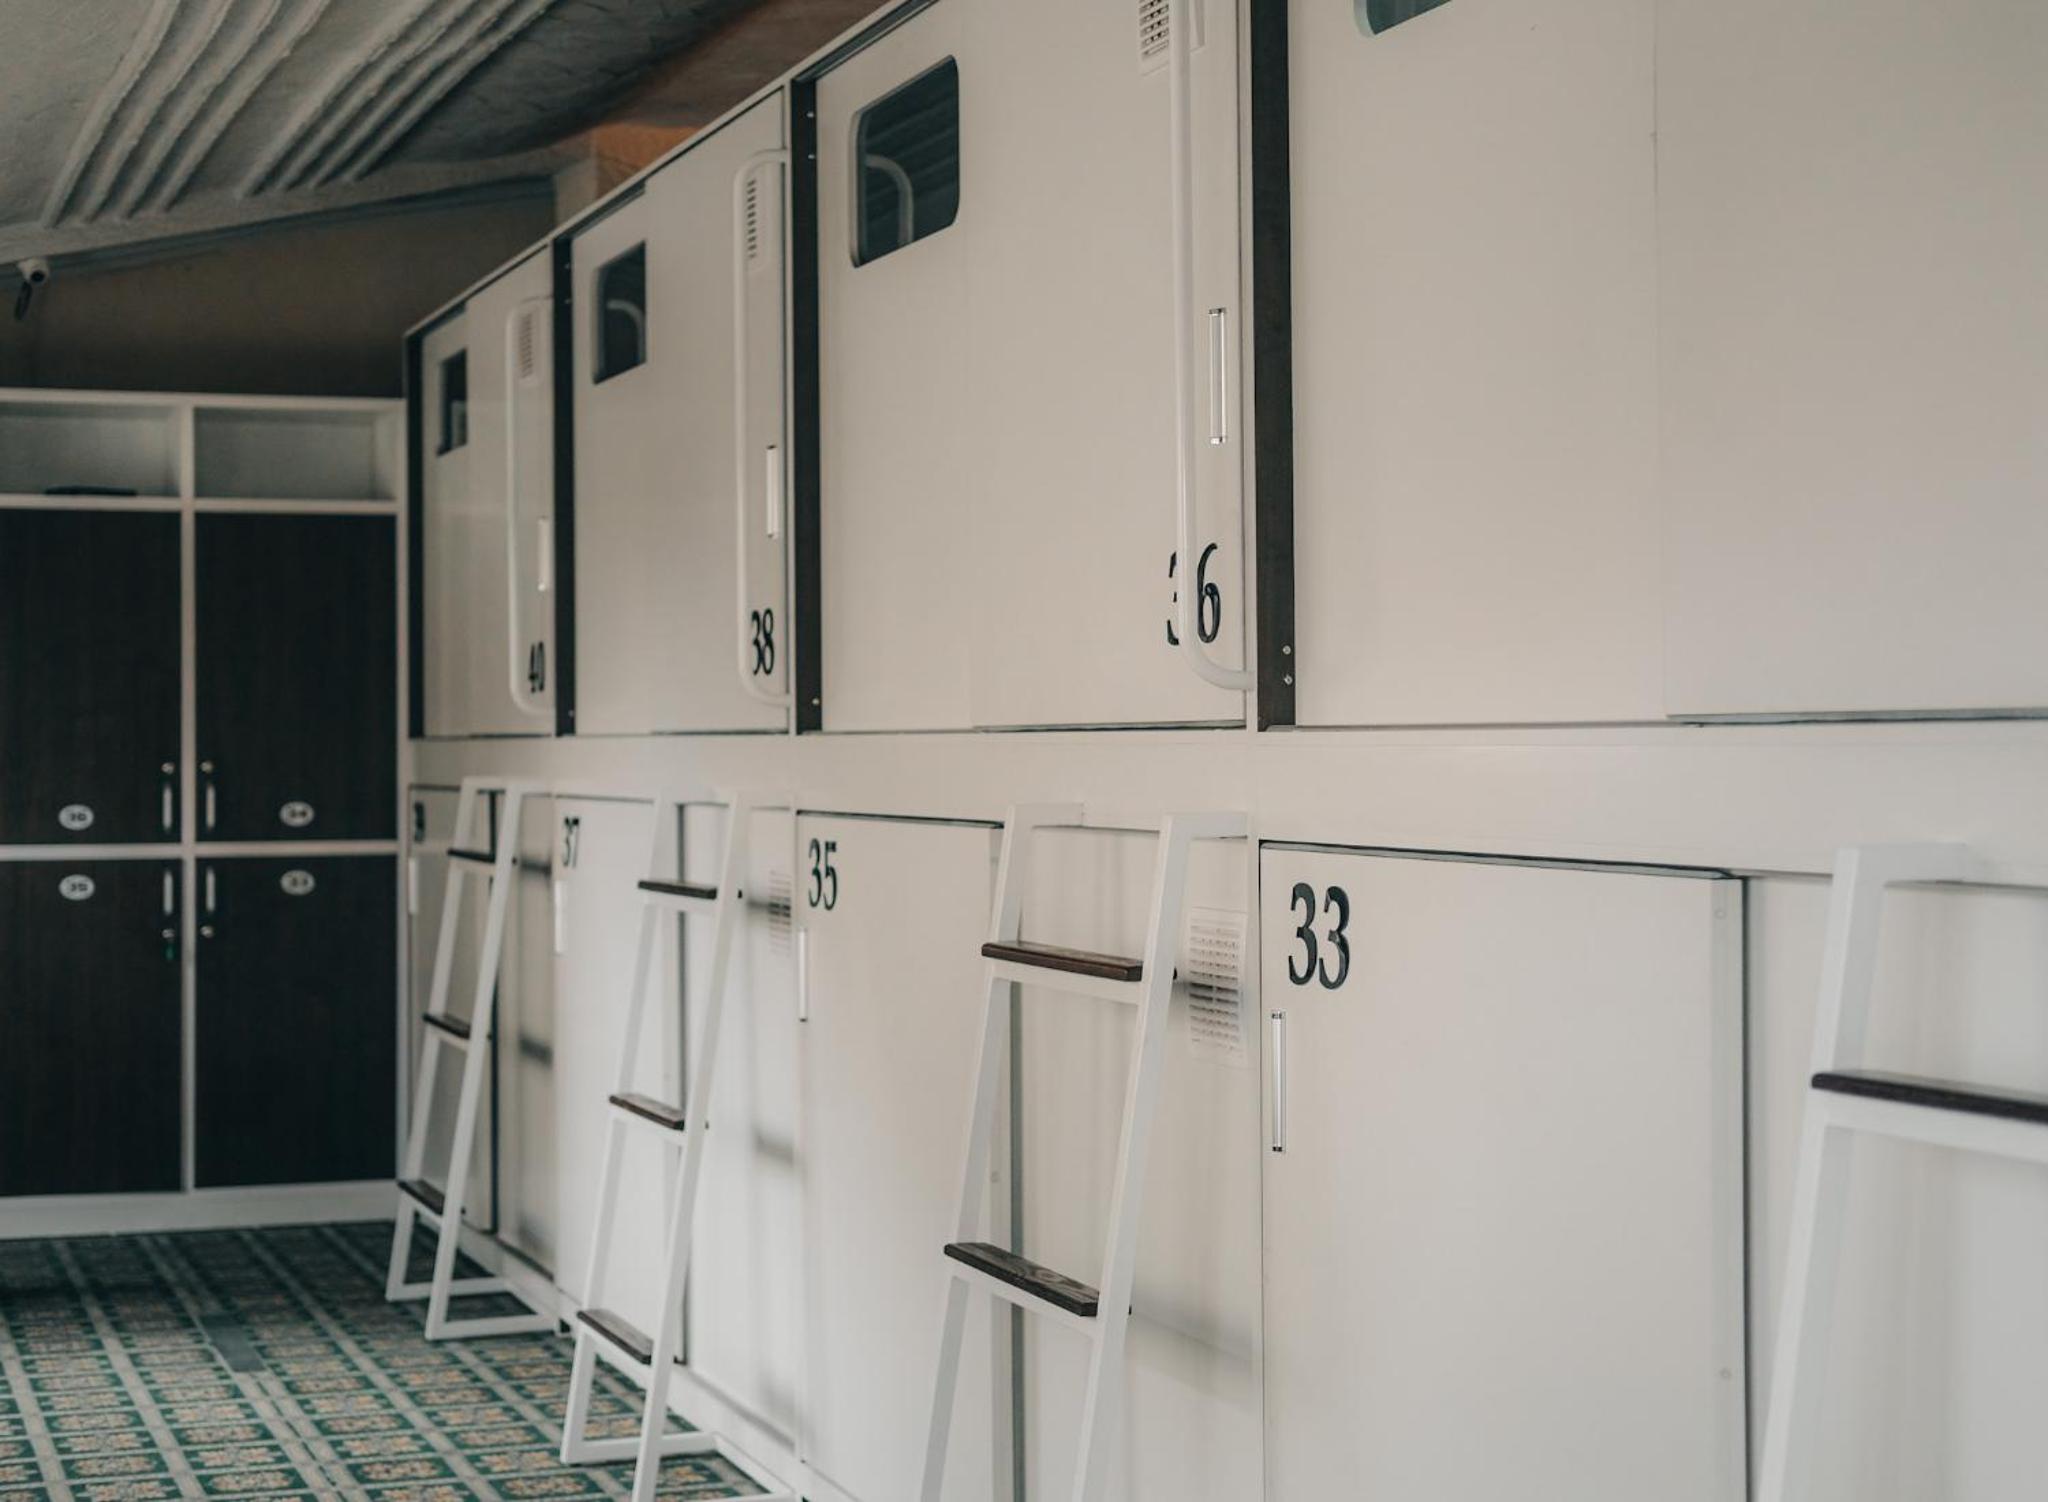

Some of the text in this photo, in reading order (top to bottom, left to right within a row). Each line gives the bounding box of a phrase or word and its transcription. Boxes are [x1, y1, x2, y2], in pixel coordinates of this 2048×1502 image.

[527, 640, 546, 694] 40
[751, 608, 775, 676] 38
[563, 816, 580, 867] 37
[809, 839, 837, 911] 35
[1288, 883, 1350, 989] 33
